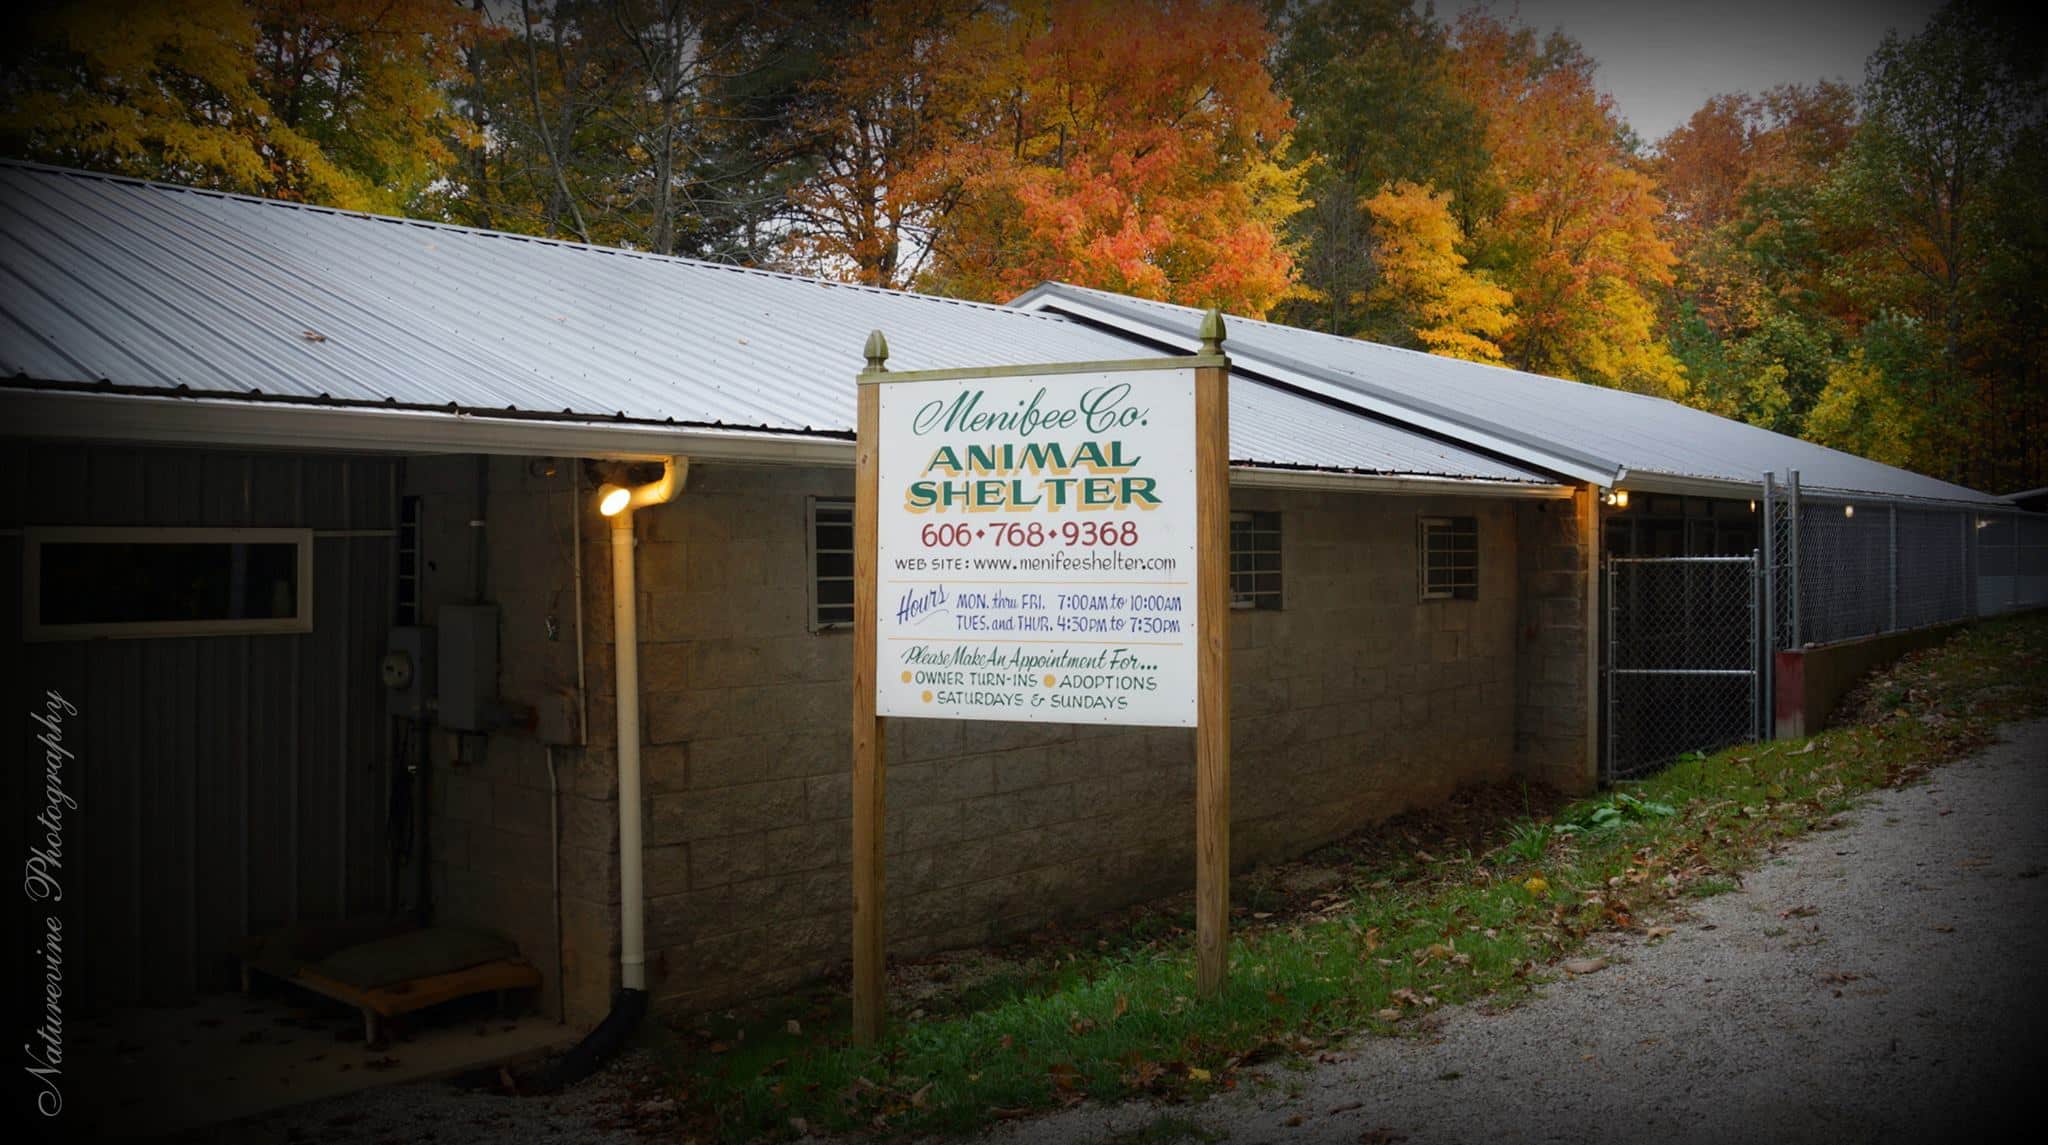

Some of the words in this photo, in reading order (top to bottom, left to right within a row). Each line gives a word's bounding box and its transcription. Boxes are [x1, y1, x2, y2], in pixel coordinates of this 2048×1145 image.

[1080, 383, 1150, 434] Co.
[925, 440, 1142, 476] ANIMAL
[907, 477, 1163, 510] SHELTER
[895, 558, 927, 570] WEB
[932, 558, 971, 570] SITE:
[974, 551, 1177, 571] www.menifeeshelter.com
[897, 584, 949, 625] Hours
[956, 593, 989, 609] MON.
[992, 588, 1017, 609] thru
[1022, 594, 1046, 610] FRI.
[1058, 594, 1109, 611] 7:00AM
[1111, 594, 1127, 610] to
[1131, 595, 1182, 612] 10:00AM
[956, 615, 990, 631] TUES.
[992, 616, 1014, 631] and
[1018, 615, 1053, 632] THUR.
[1110, 616, 1126, 631] to
[1130, 617, 1181, 633] 7:30PM
[901, 645, 950, 667] Please
[948, 646, 986, 667] Make
[985, 646, 1007, 668] An
[1007, 647, 1107, 672] Appointment
[1110, 648, 1158, 670] For...
[915, 670, 964, 686] OWNER
[970, 672, 1038, 688] TURN-INS
[1059, 674, 1157, 691] ADOPTIONS
[937, 691, 1024, 706] SATURDAYS
[1030, 693, 1045, 708] &
[1050, 694, 1128, 710] SUNDAYS
